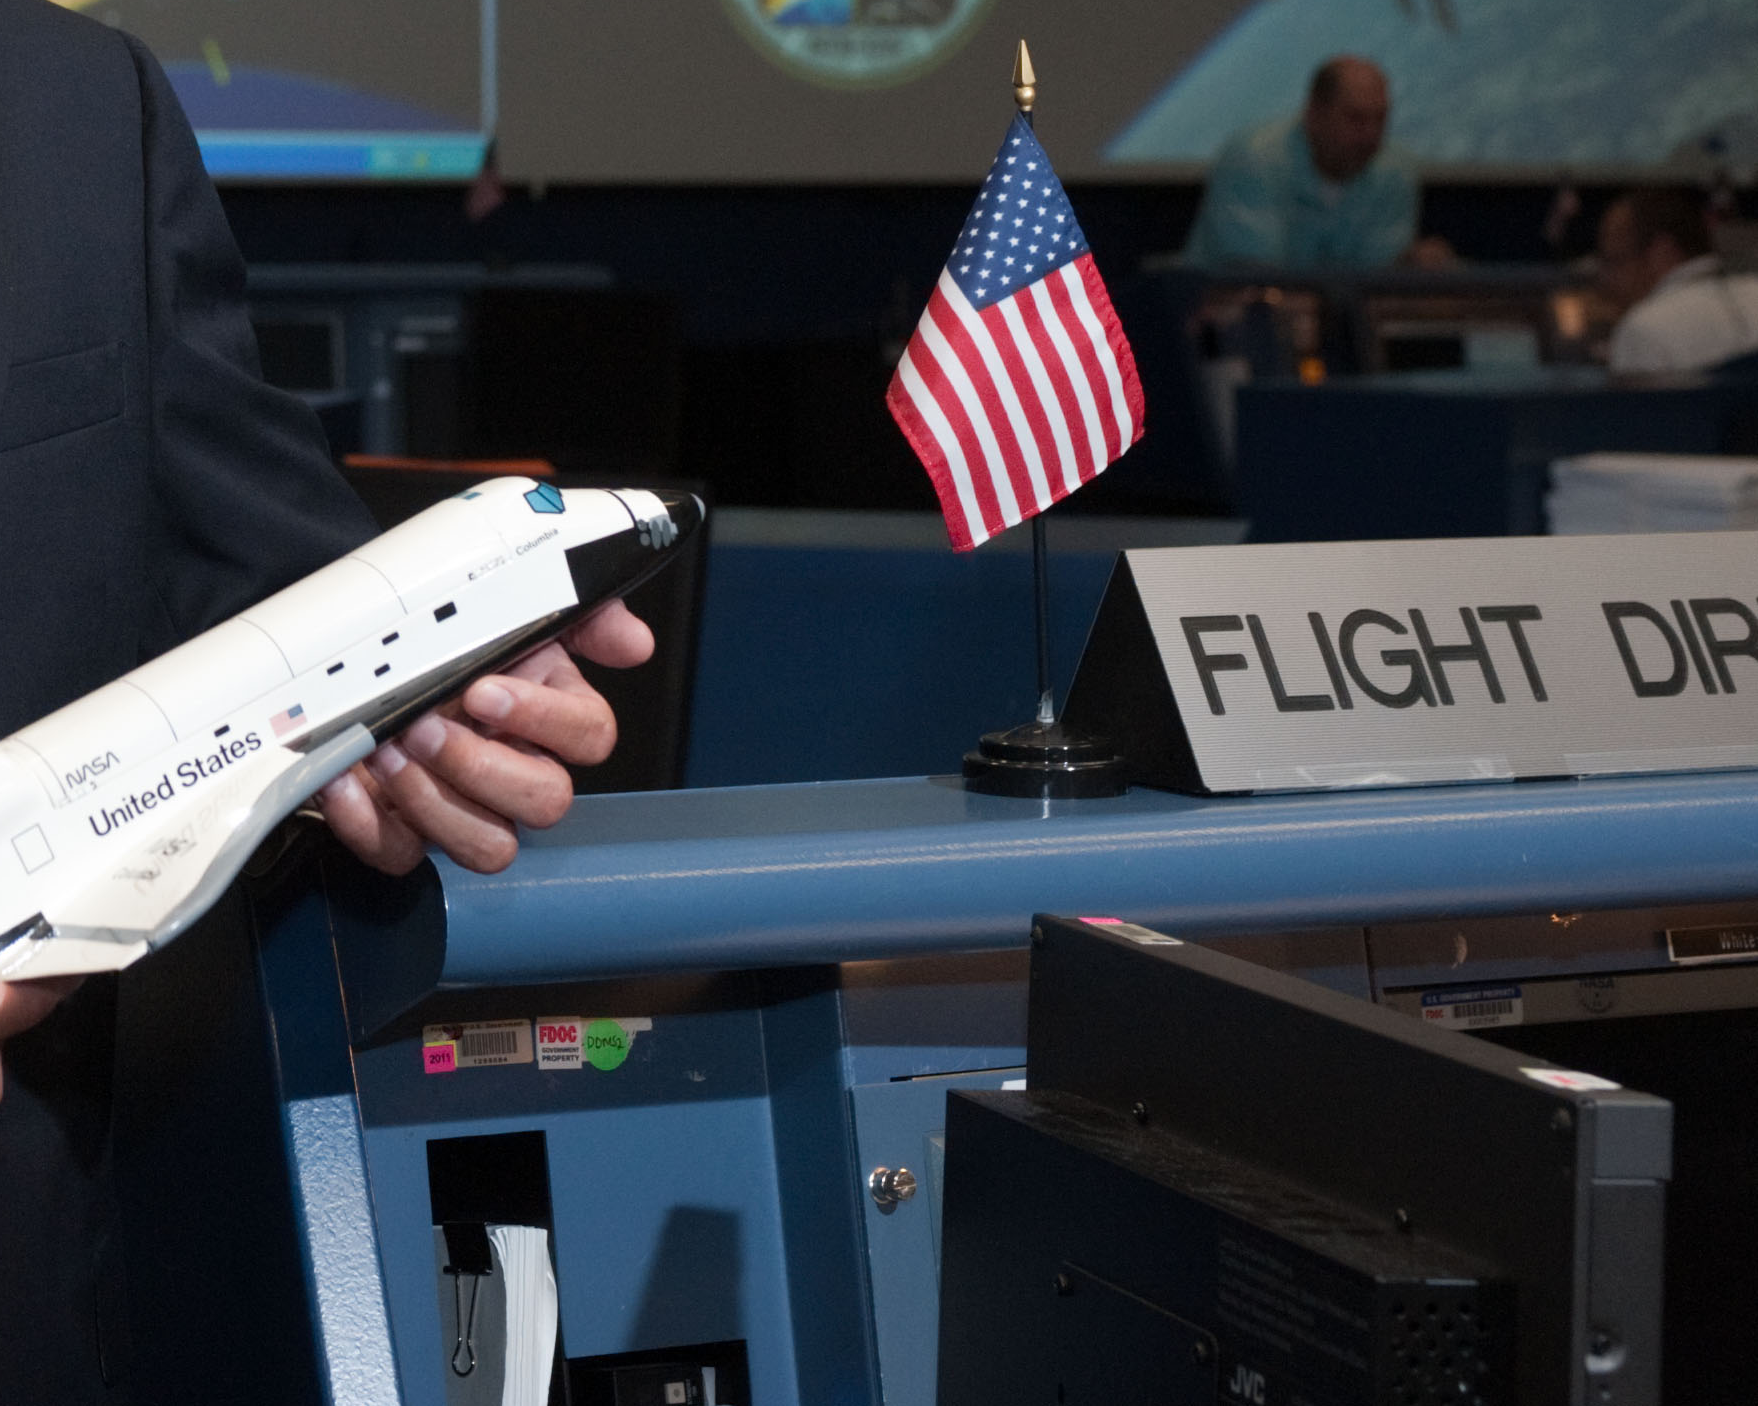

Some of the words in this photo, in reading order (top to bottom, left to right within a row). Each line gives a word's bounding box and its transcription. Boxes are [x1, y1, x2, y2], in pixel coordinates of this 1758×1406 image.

[515, 528, 558, 556] Columbia
[1179, 604, 1549, 716] FLIGHT
[1601, 597, 1758, 698] DIR
[65, 751, 121, 790] NASA
[88, 773, 176, 838] United
[176, 730, 262, 788] States
[539, 1025, 577, 1043] FDOC
[429, 1053, 452, 1065] 2011
[1230, 1364, 1266, 1405] JVC
